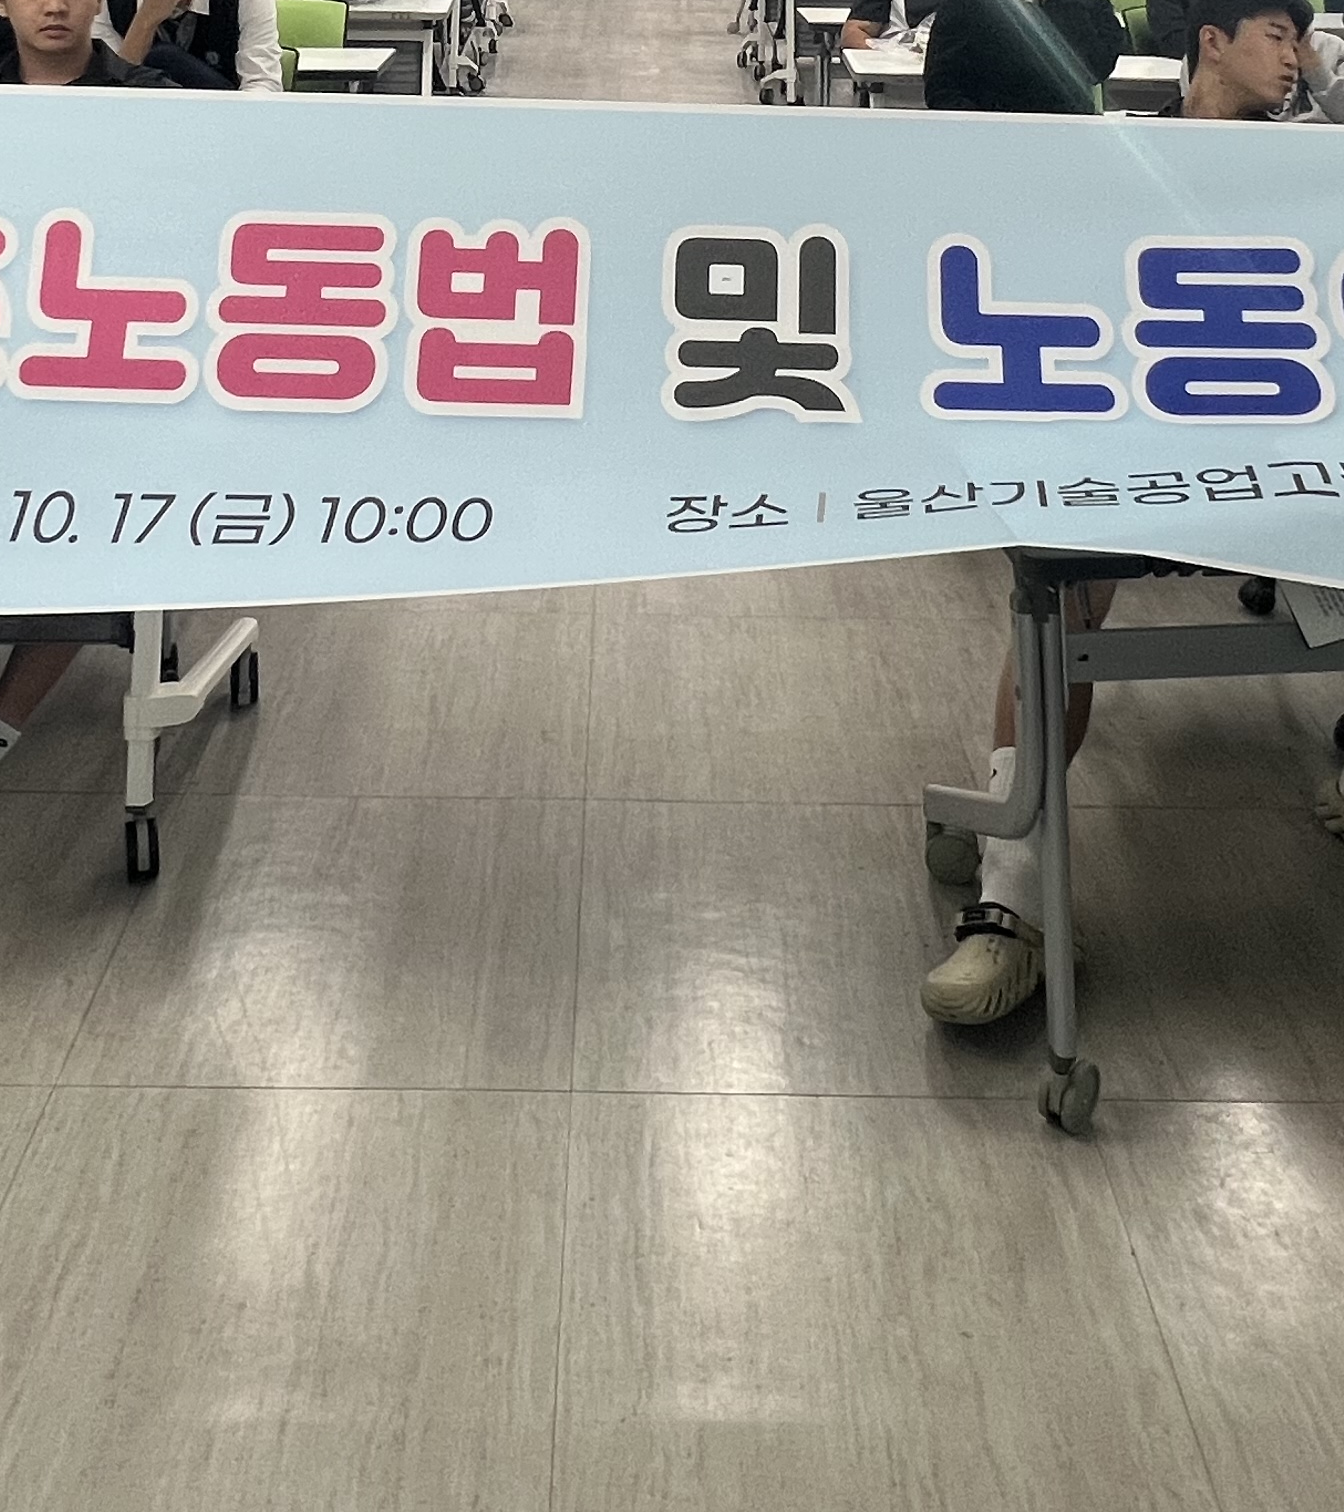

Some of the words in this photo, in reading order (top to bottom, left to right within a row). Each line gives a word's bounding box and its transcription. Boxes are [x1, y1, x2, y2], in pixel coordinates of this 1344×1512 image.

[672, 234, 847, 413] 및
[8, 489, 78, 544] 10.
[319, 495, 494, 544] 10:00
[666, 493, 789, 533] 장소
